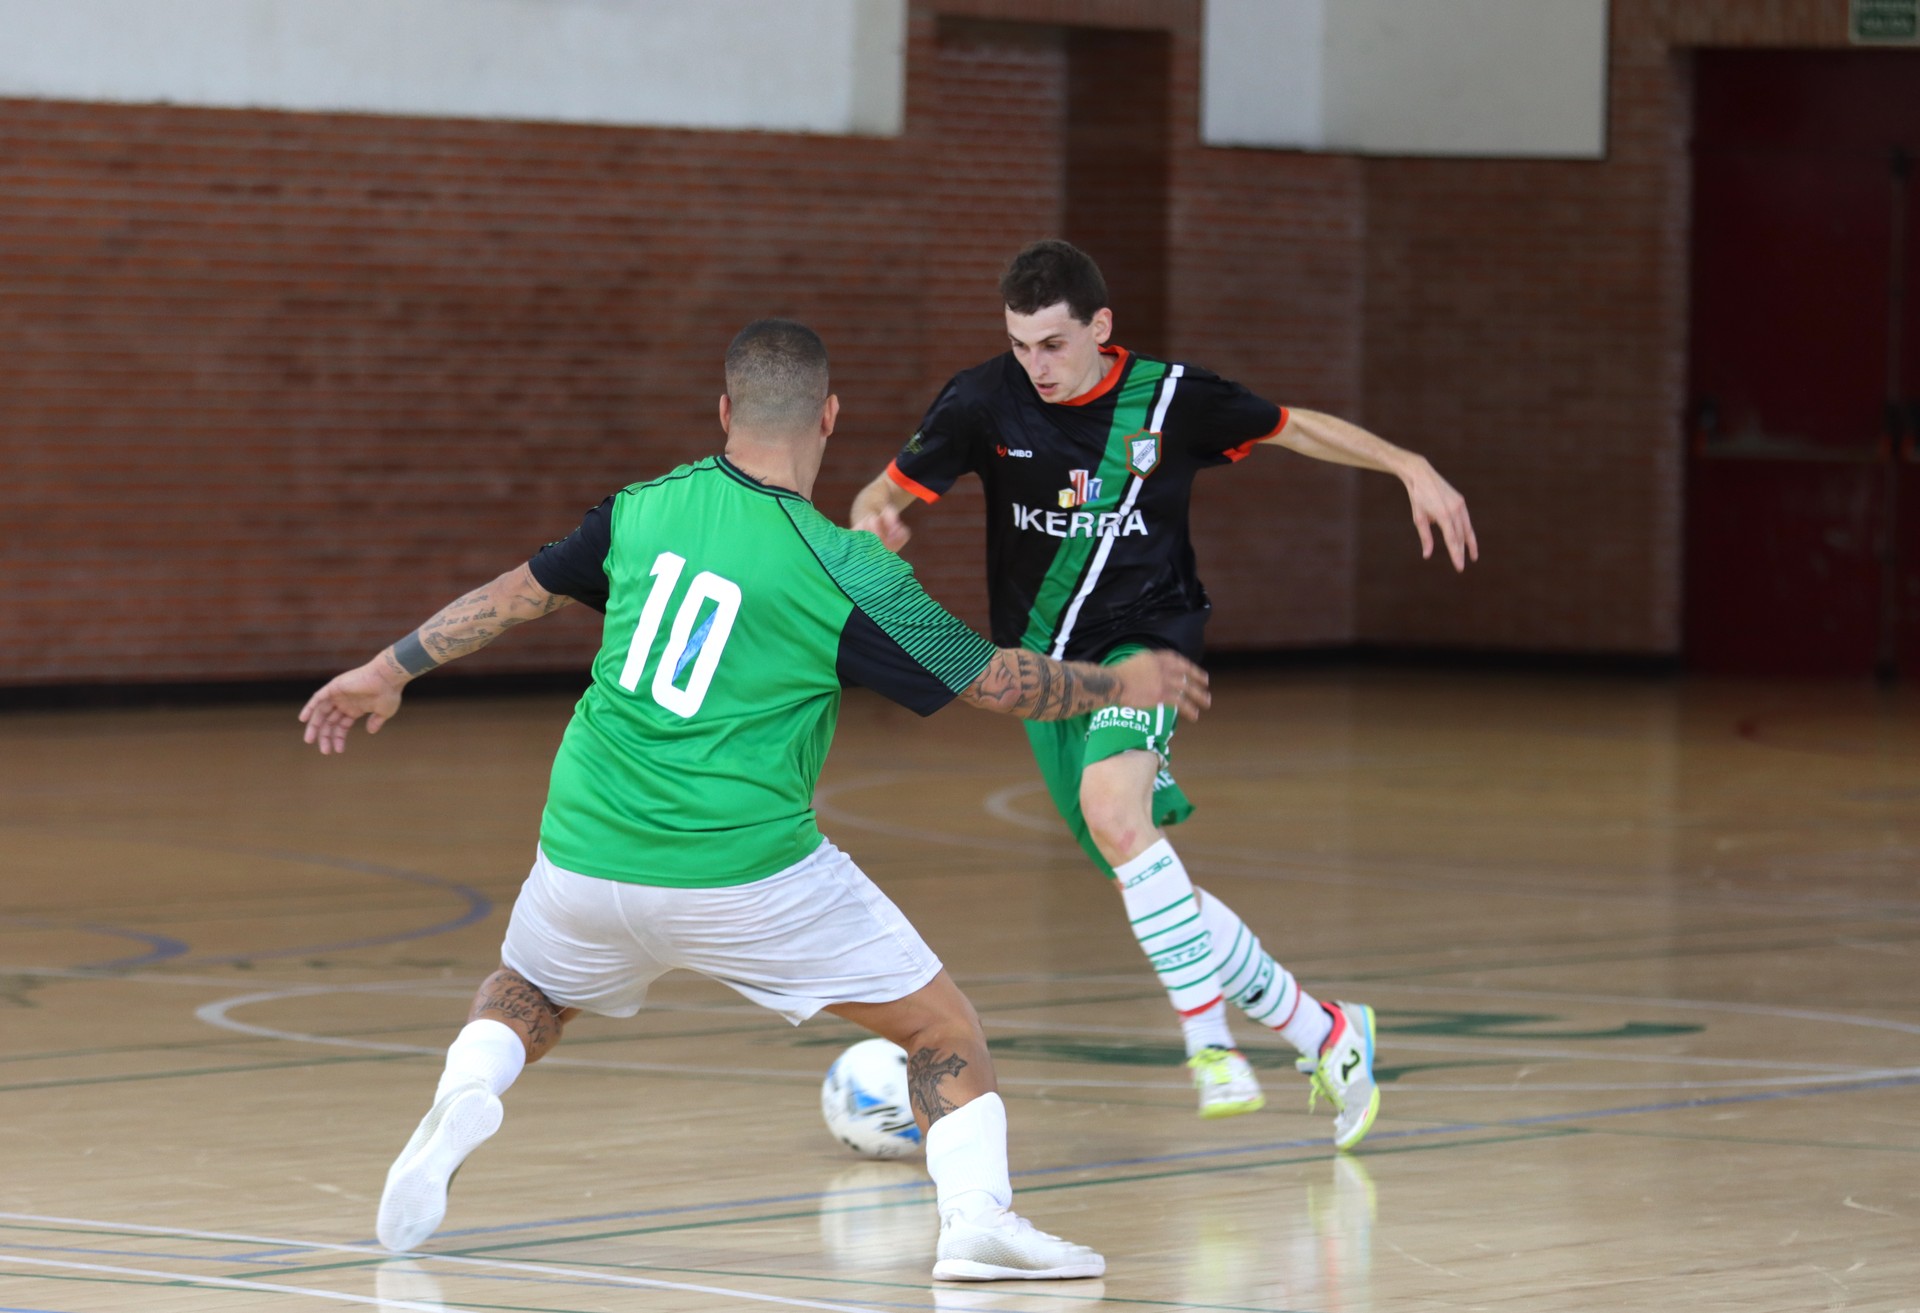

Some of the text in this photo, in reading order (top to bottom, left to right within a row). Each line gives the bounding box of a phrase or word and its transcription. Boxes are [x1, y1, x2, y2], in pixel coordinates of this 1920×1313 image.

[1007, 448, 1033, 459] WIBO
[1012, 503, 1149, 538] IKERRA
[618, 551, 742, 719] 10
